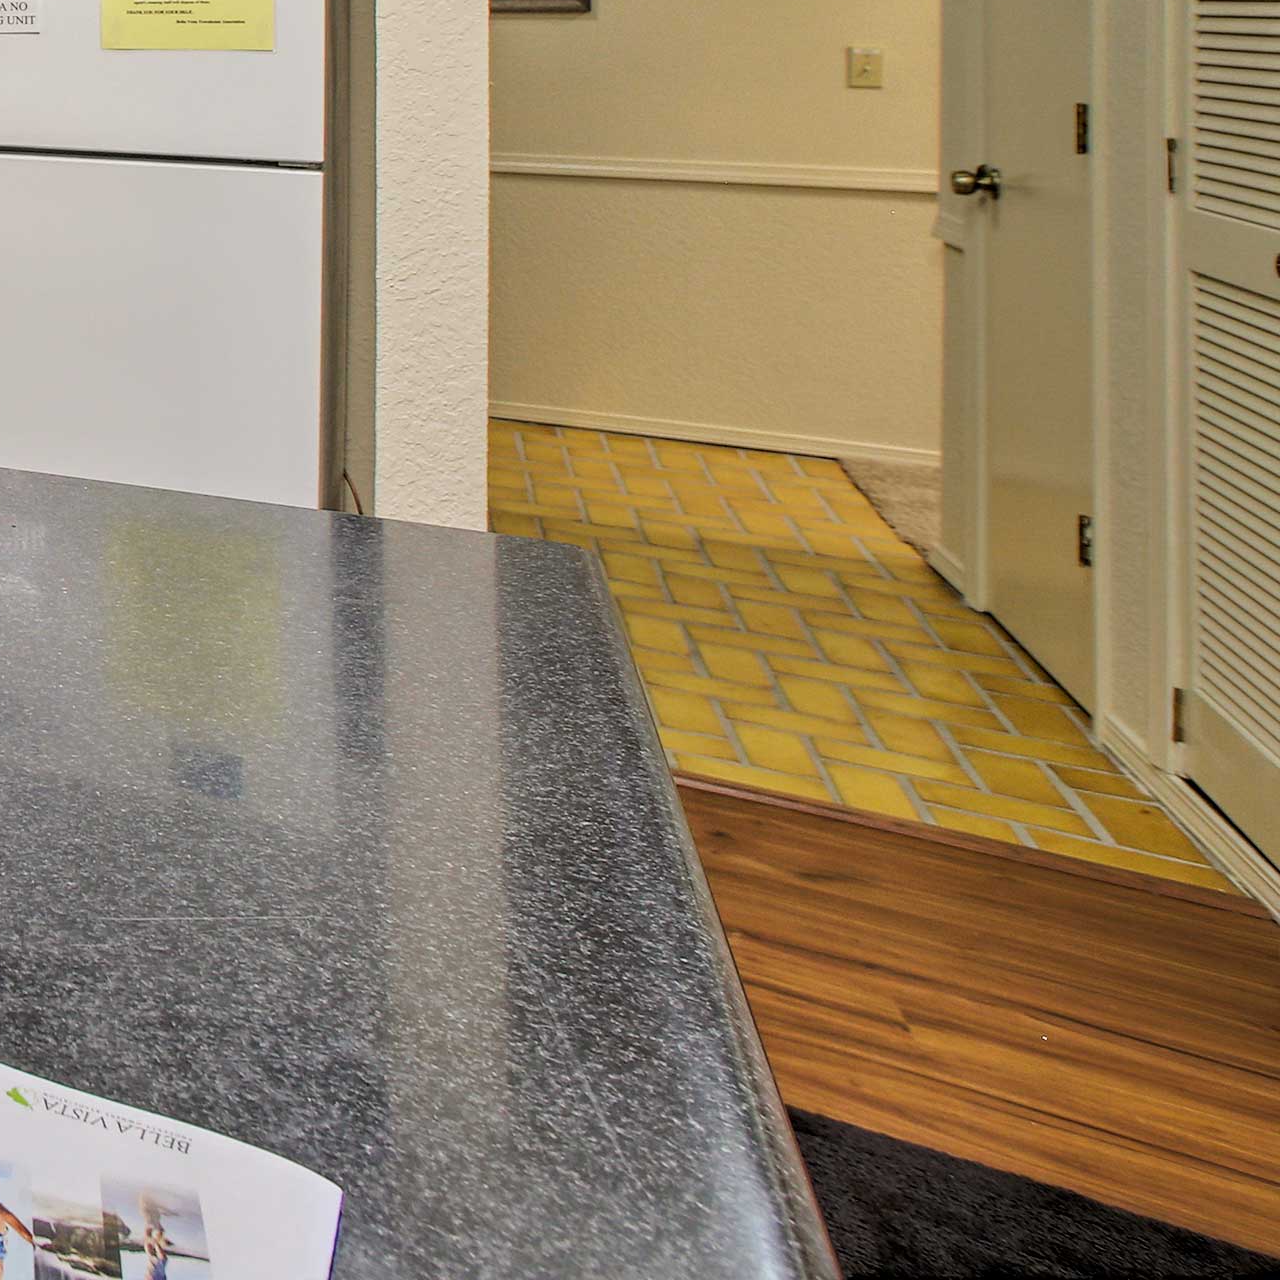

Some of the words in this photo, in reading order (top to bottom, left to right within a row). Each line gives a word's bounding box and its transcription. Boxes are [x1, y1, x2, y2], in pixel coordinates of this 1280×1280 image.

[0, 2, 8, 11] A
[10, 1, 28, 12] NO
[7, 15, 36, 25] UNIT
[42, 1097, 108, 1130] VISTA
[116, 1120, 190, 1154] BELLA
